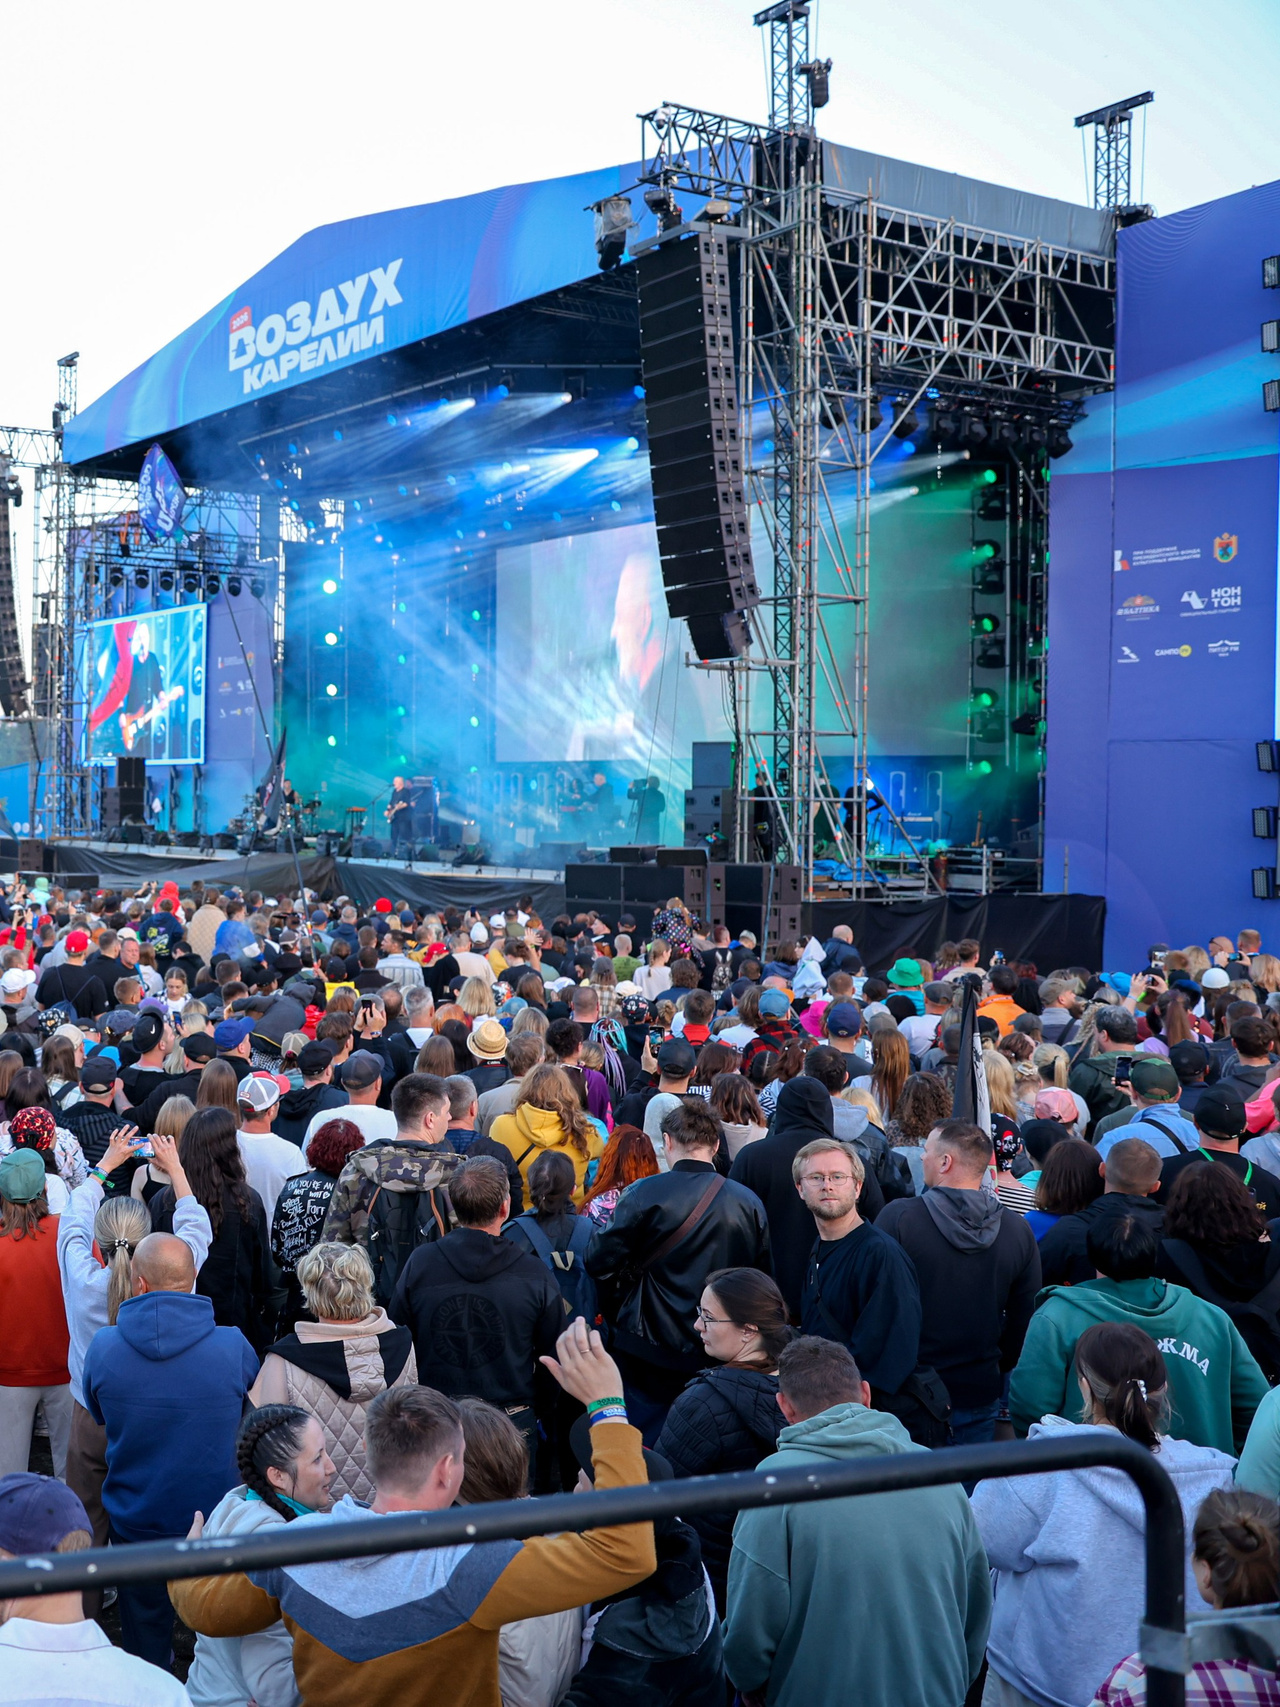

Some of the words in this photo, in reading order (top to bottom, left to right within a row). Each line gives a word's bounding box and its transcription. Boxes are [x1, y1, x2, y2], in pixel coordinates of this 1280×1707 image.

[229, 257, 404, 372] ВОЗДУХ
[243, 315, 384, 394] КАРЕЛИИ
[1211, 586, 1241, 598] НОН
[1211, 595, 1241, 608] ТОН
